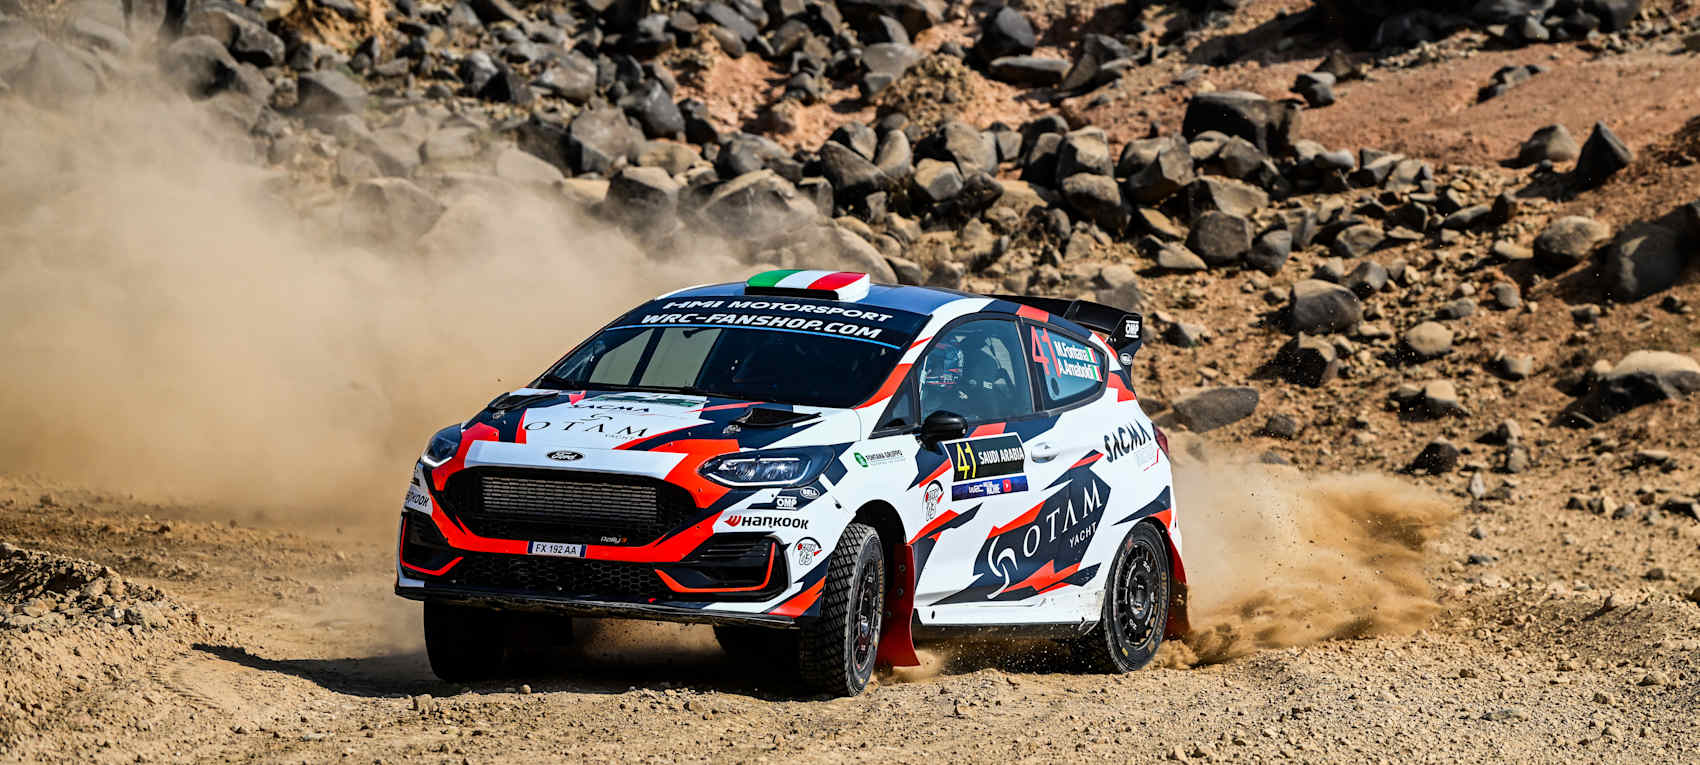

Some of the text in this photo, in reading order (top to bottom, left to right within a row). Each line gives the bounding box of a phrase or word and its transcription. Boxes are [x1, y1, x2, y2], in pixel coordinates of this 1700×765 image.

[663, 300, 894, 323] HMI MOTORSPORT
[641, 313, 883, 339] WRC-FANSHOP.COM
[1031, 325, 1062, 378] 41
[524, 421, 648, 437] OTAM
[1104, 418, 1151, 463] SACMA
[551, 451, 579, 461] Ford
[957, 441, 977, 479] 41
[978, 447, 1025, 465] SAUDI ARABIA
[776, 497, 797, 508] OMP
[1023, 479, 1103, 558] OTAM
[1069, 521, 1098, 548] YACHT
[535, 543, 577, 555] FX 192 AA
